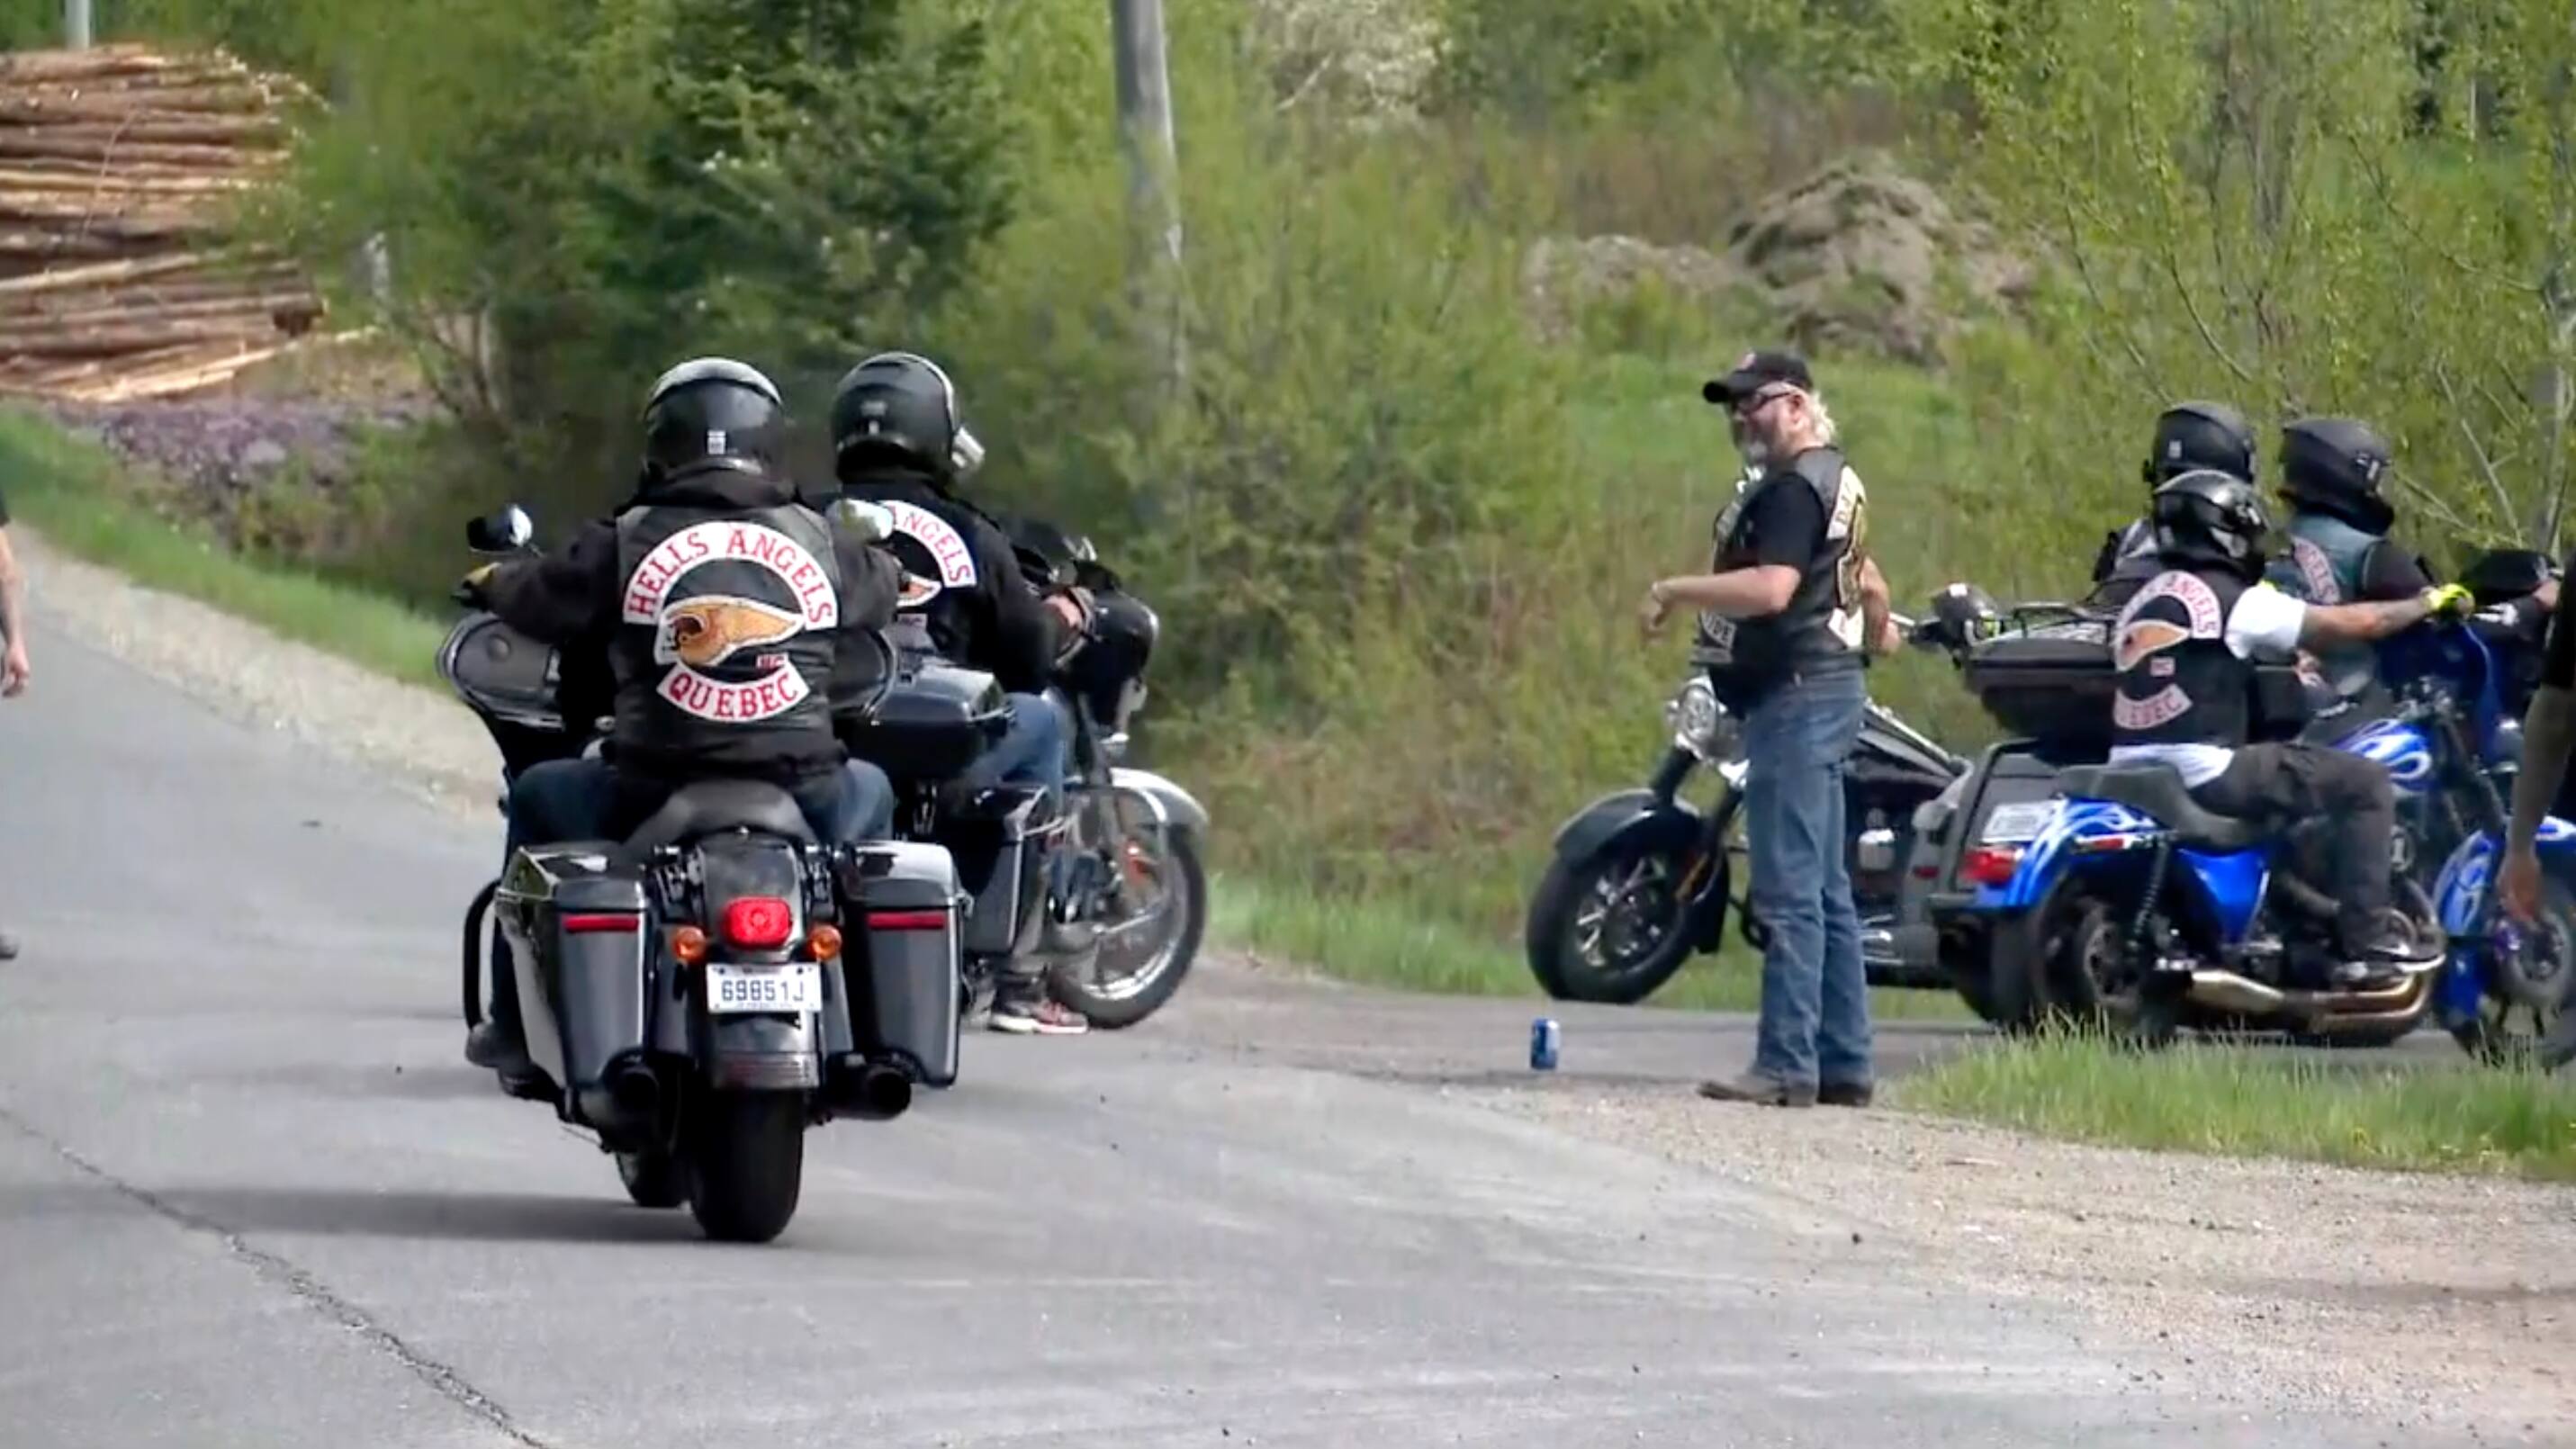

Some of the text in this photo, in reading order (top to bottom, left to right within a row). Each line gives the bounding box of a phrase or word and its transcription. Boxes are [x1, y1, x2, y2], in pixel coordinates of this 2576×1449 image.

[626, 528, 833, 624] HELLS ANGELS
[667, 671, 798, 718] QUEBEC
[721, 979, 804, 1002] 69851J
